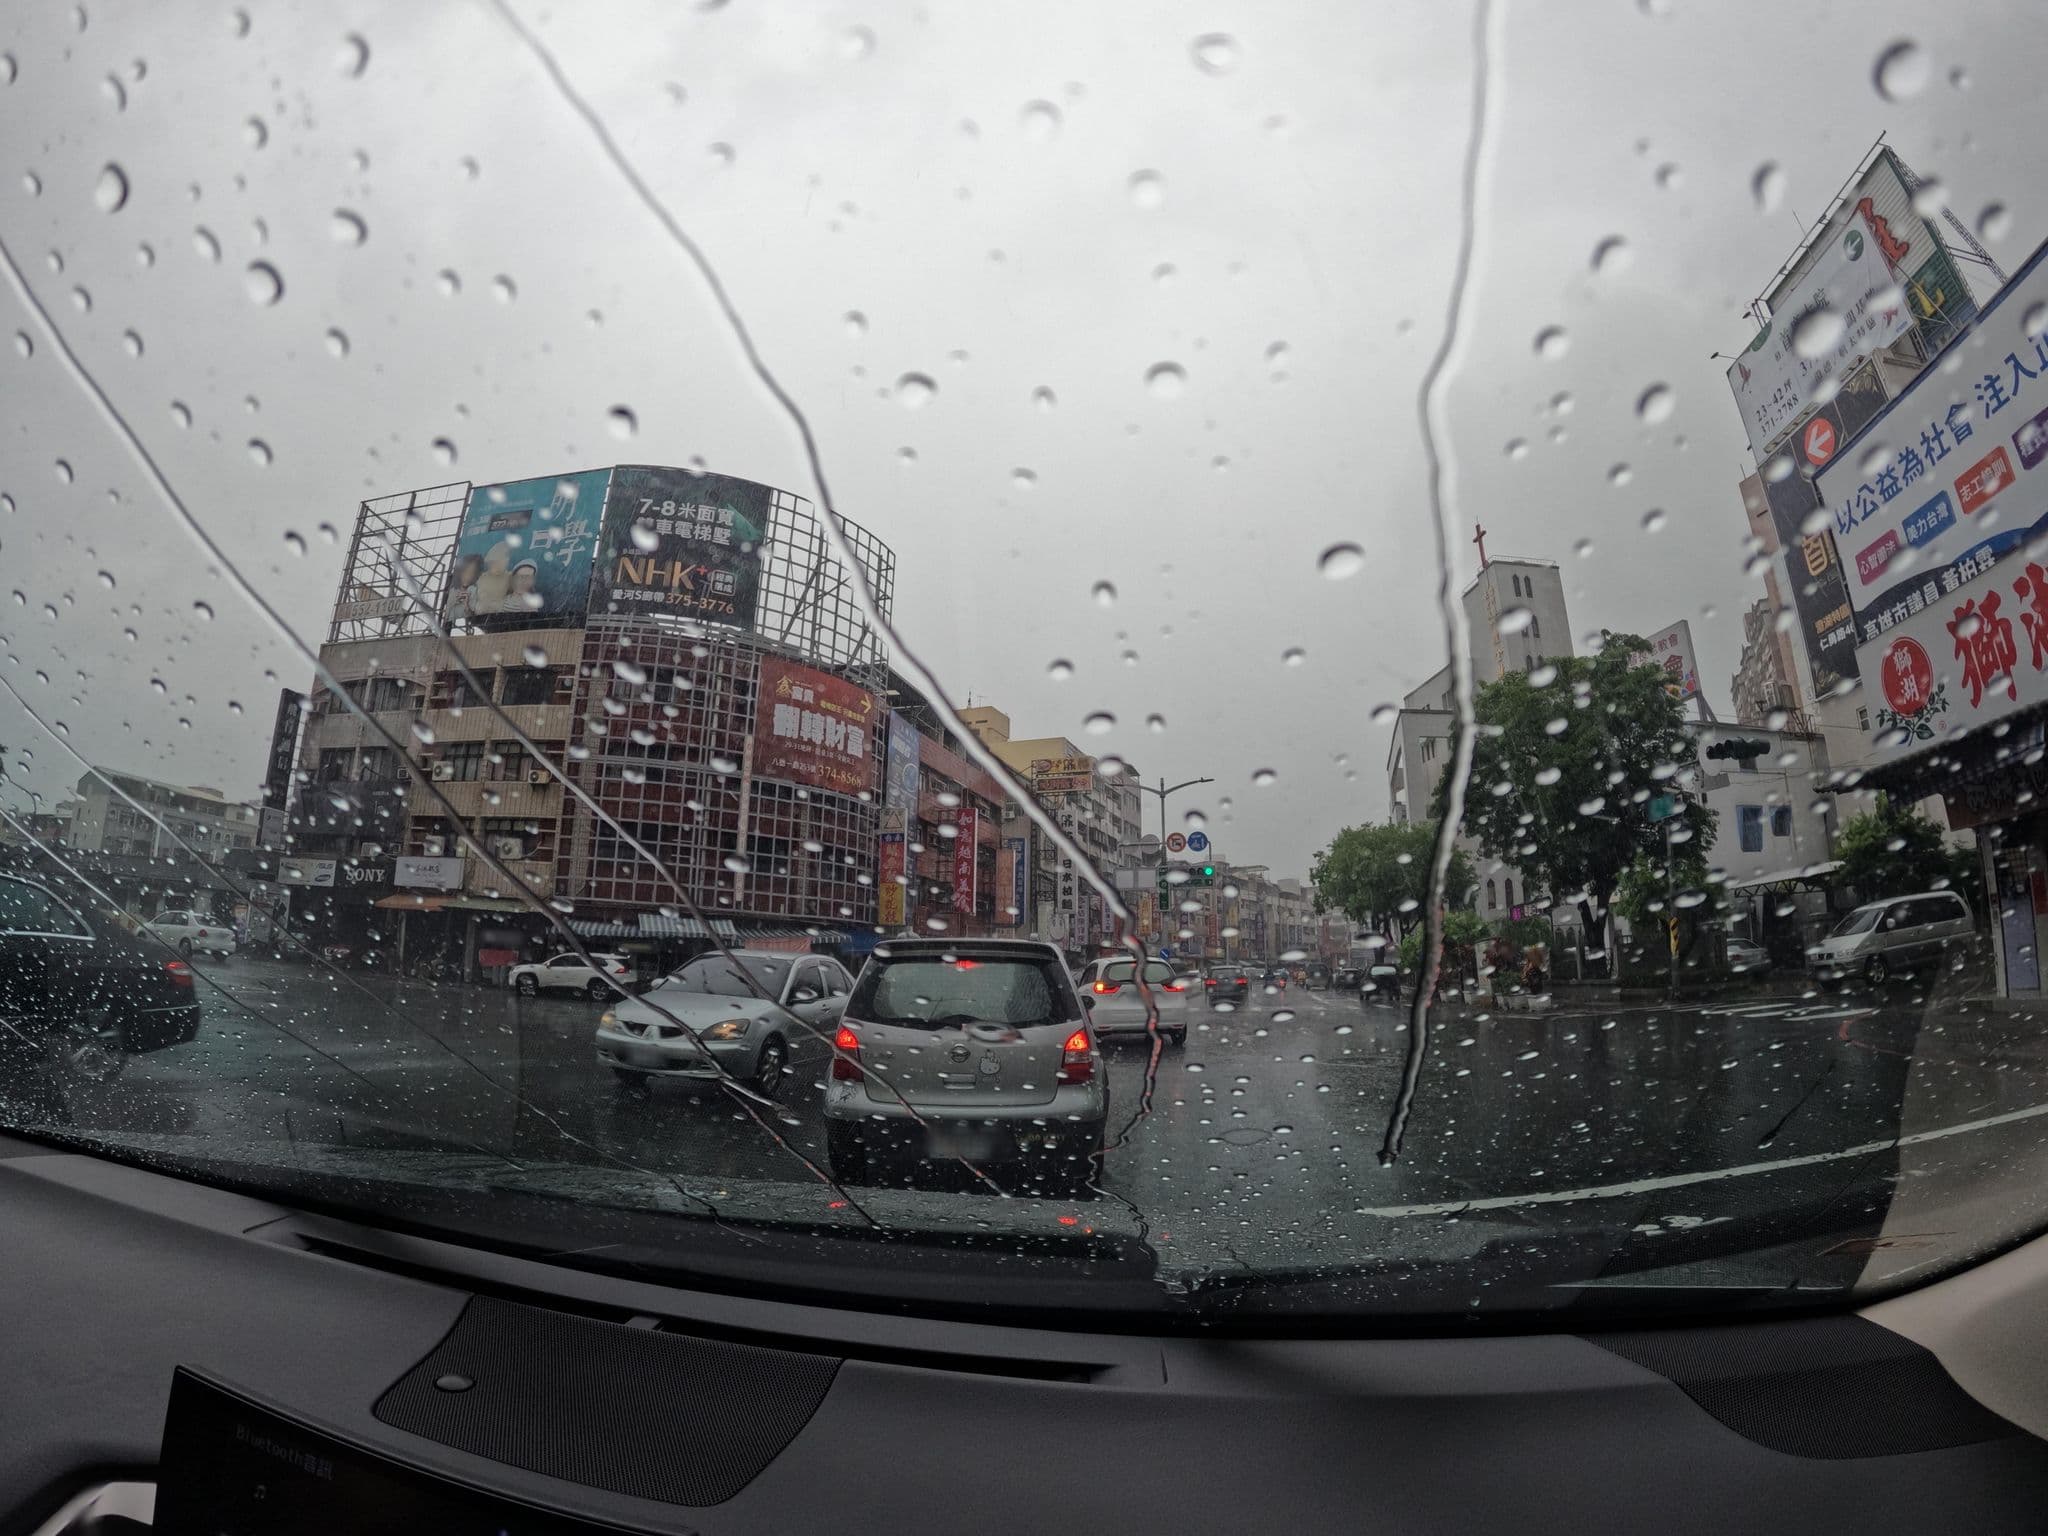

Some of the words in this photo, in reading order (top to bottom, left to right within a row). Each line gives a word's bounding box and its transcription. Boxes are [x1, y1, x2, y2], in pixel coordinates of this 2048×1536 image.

[1760, 393, 1800, 437] 371-2788
[1835, 401, 1974, 537] 以公益為社會
[665, 592, 735, 615] 375-3776
[1863, 581, 1940, 641] 高雄市議員
[1893, 646, 1920, 705] 獅湖
[345, 867, 386, 883] SONY
